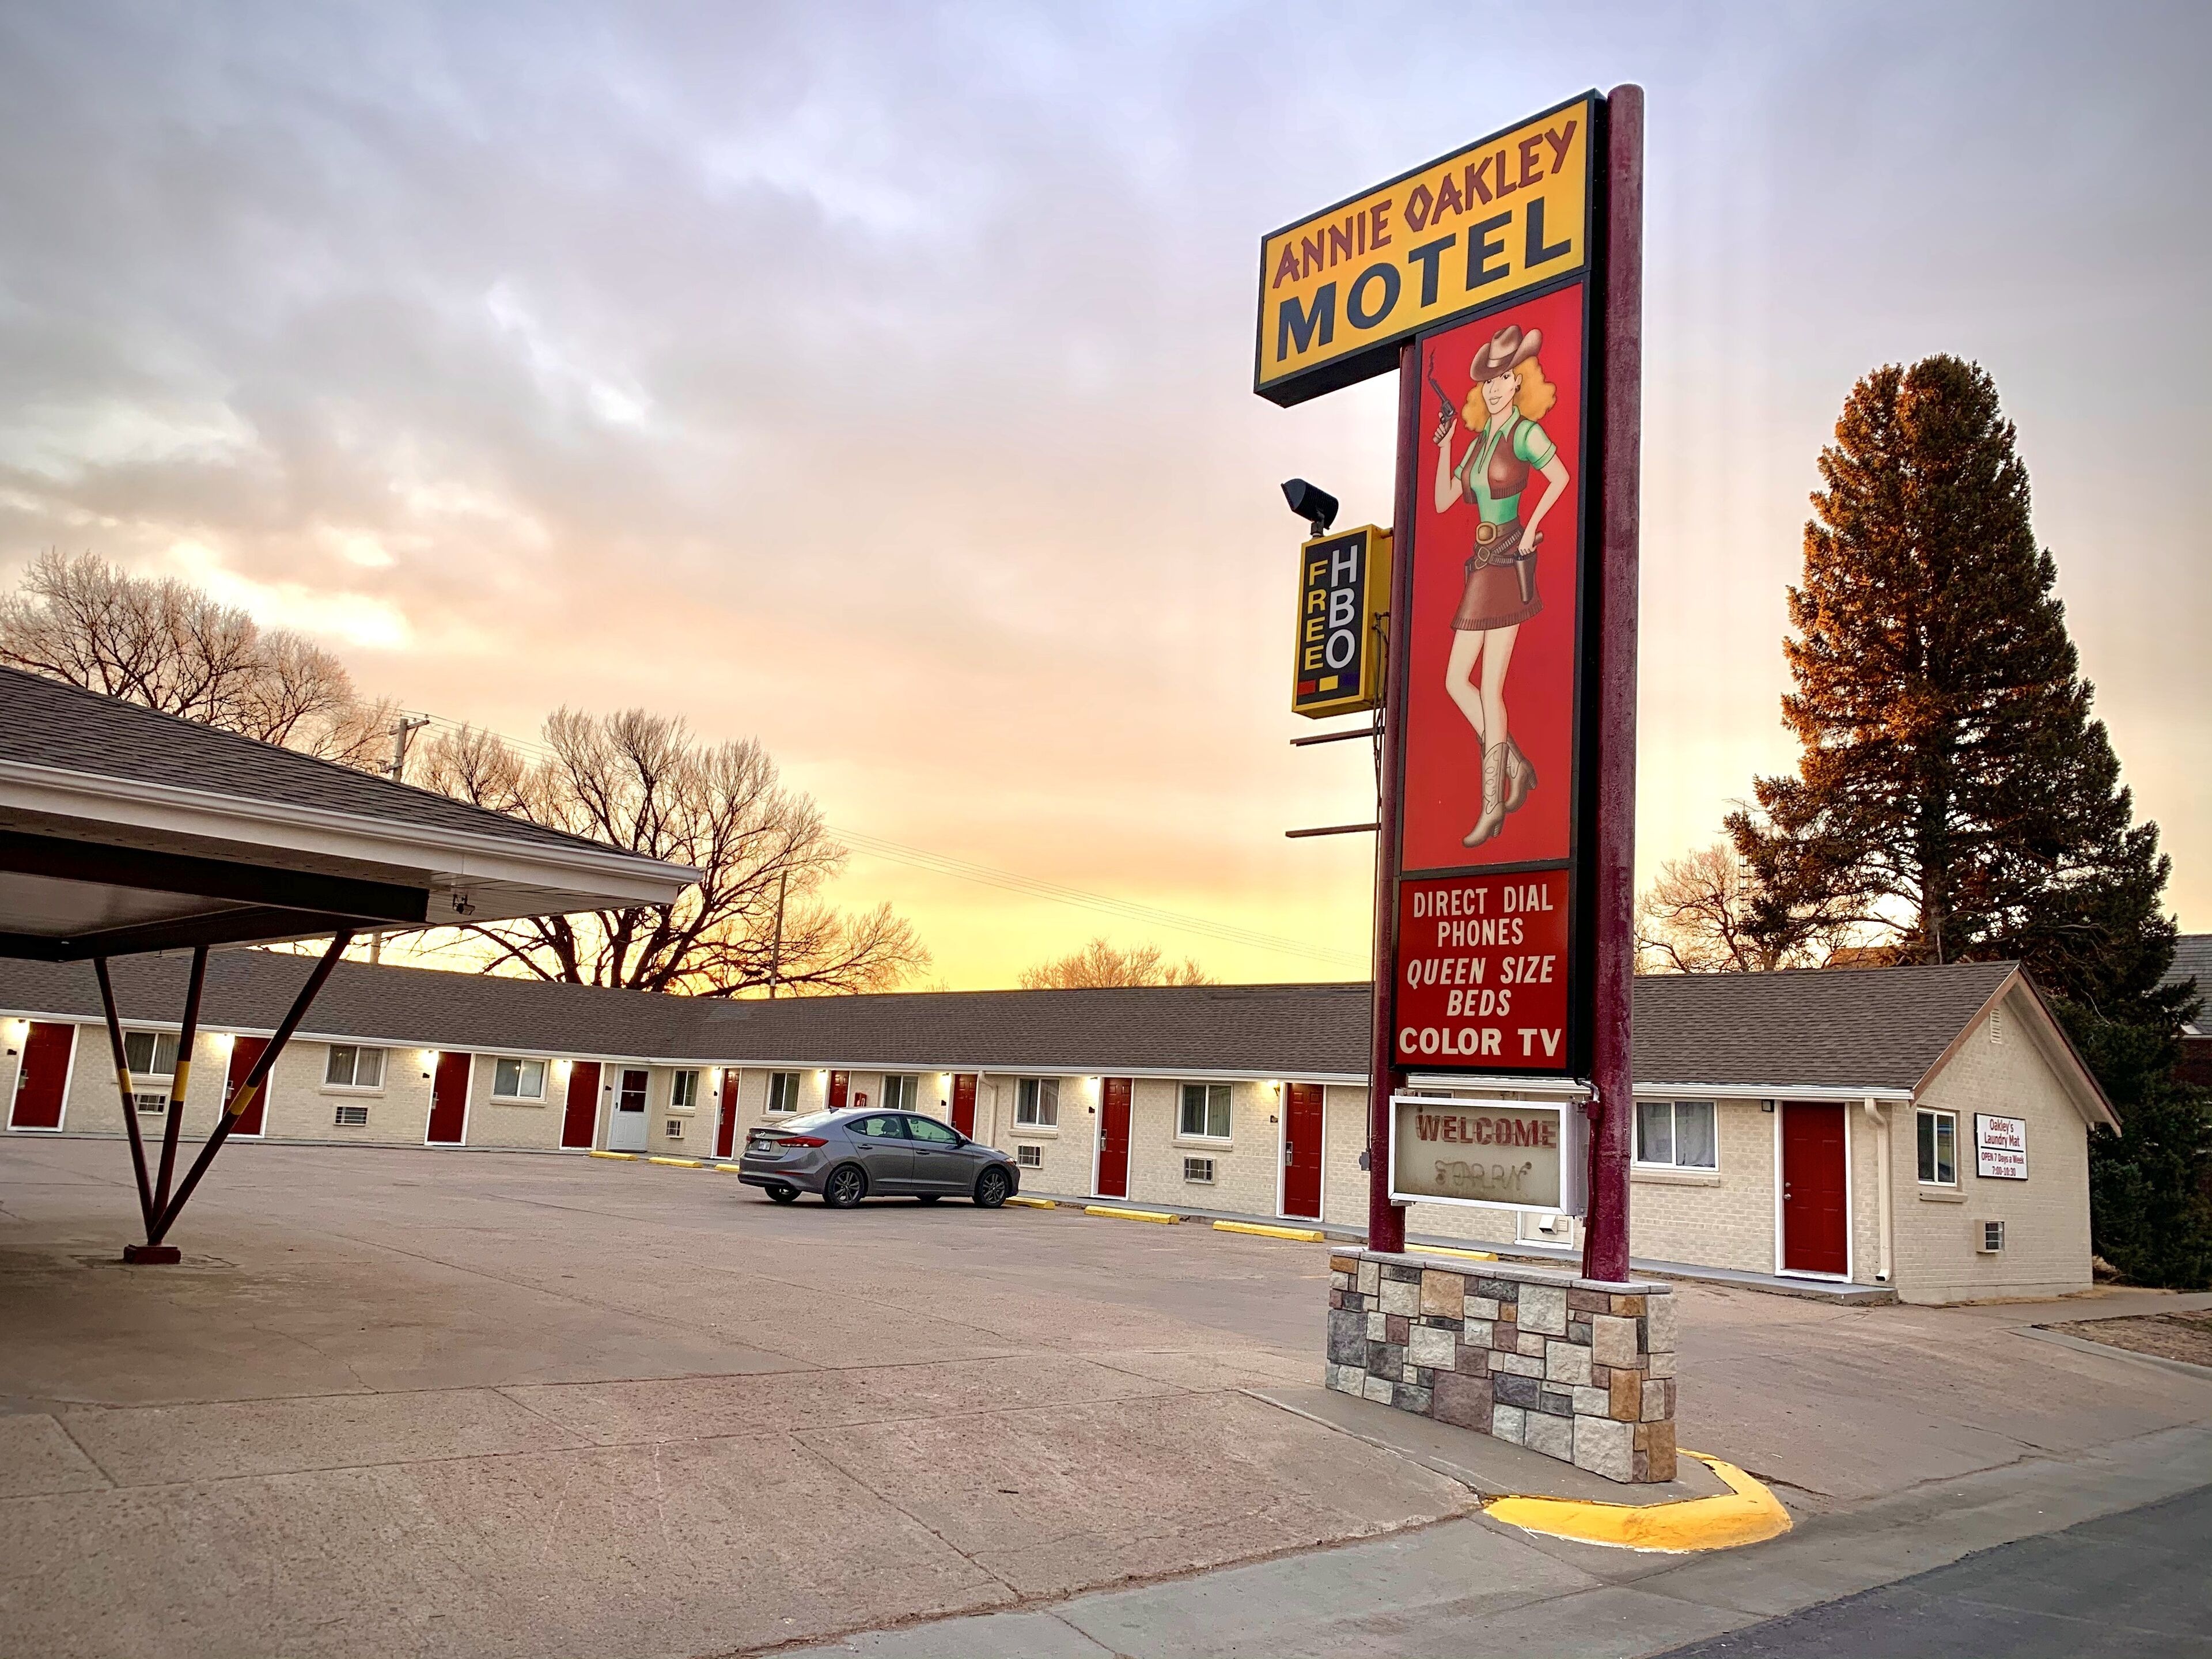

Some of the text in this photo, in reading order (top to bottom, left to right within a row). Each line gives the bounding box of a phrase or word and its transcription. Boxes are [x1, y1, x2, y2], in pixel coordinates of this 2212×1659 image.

[1272, 120, 1577, 288] ANNIE OAKLEY
[1277, 196, 1571, 362] MOTEL
[1305, 559, 1328, 671] FREE
[1325, 544, 1358, 669] HBO
[1413, 884, 1554, 918] DIRECT DIAL
[1438, 918, 1524, 947] PHONES
[1407, 955, 1556, 990] QUEEN SIZE
[1446, 989, 1512, 1016] BEDS
[1399, 1027, 1562, 1056] COLOR TV
[1415, 1114, 1557, 1149] WELCOME
[1984, 1132, 2020, 1148] Laundry Mat
[1990, 1119, 2014, 1134] Oakley's
[1982, 1152, 1994, 1161] OPEN
[1994, 1153, 1997, 1161] 7
[1998, 1154, 2008, 1164] Days
[2013, 1155, 2024, 1164] Week
